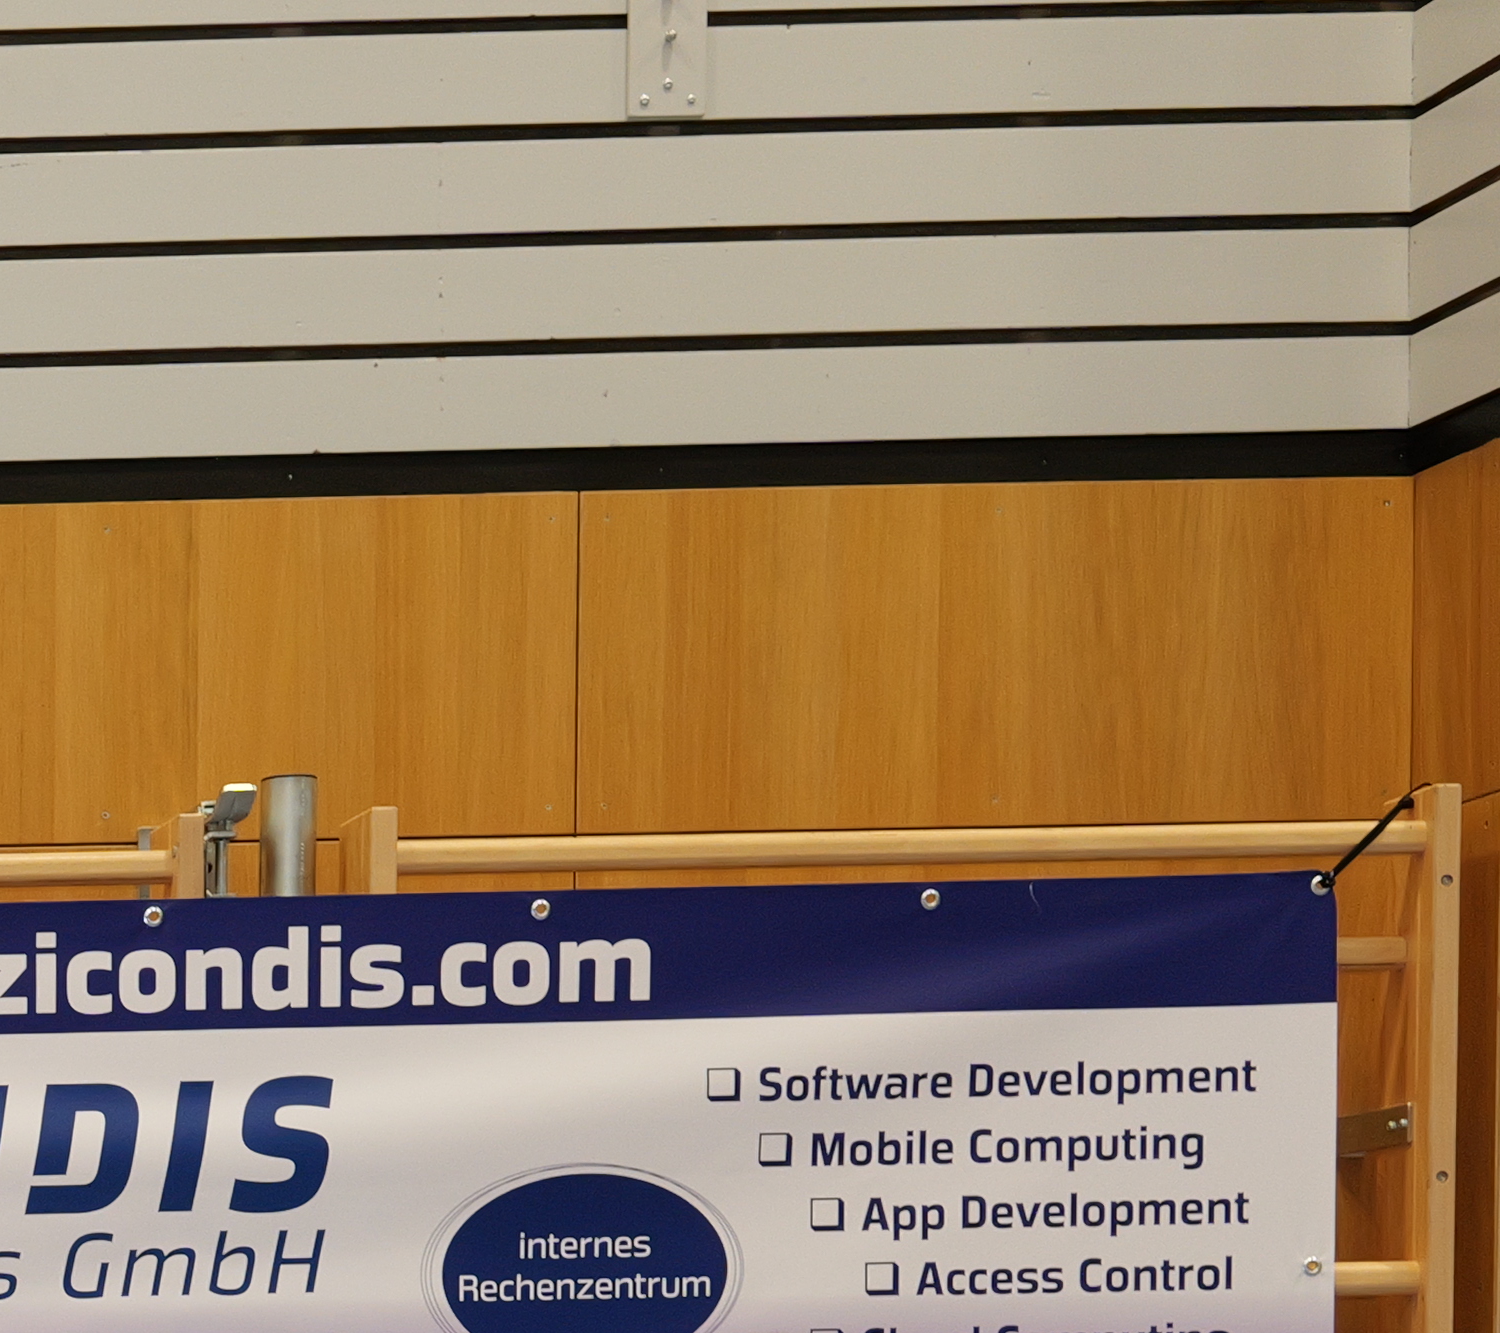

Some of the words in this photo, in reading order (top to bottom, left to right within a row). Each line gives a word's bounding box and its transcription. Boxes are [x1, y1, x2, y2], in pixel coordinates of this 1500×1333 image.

[758, 1066, 953, 1102] Software
[969, 1060, 1257, 1104] Development
[810, 1130, 954, 1168] Mobile
[969, 1126, 1205, 1172] Computing
[862, 1197, 946, 1241] App
[961, 1192, 1250, 1237] Development
[62, 1229, 326, 1299] GmbH
[519, 1231, 652, 1260] internes
[458, 1273, 712, 1302] Rechenzentrum
[916, 1261, 1064, 1297] Access
[1079, 1256, 1234, 1293] Control
